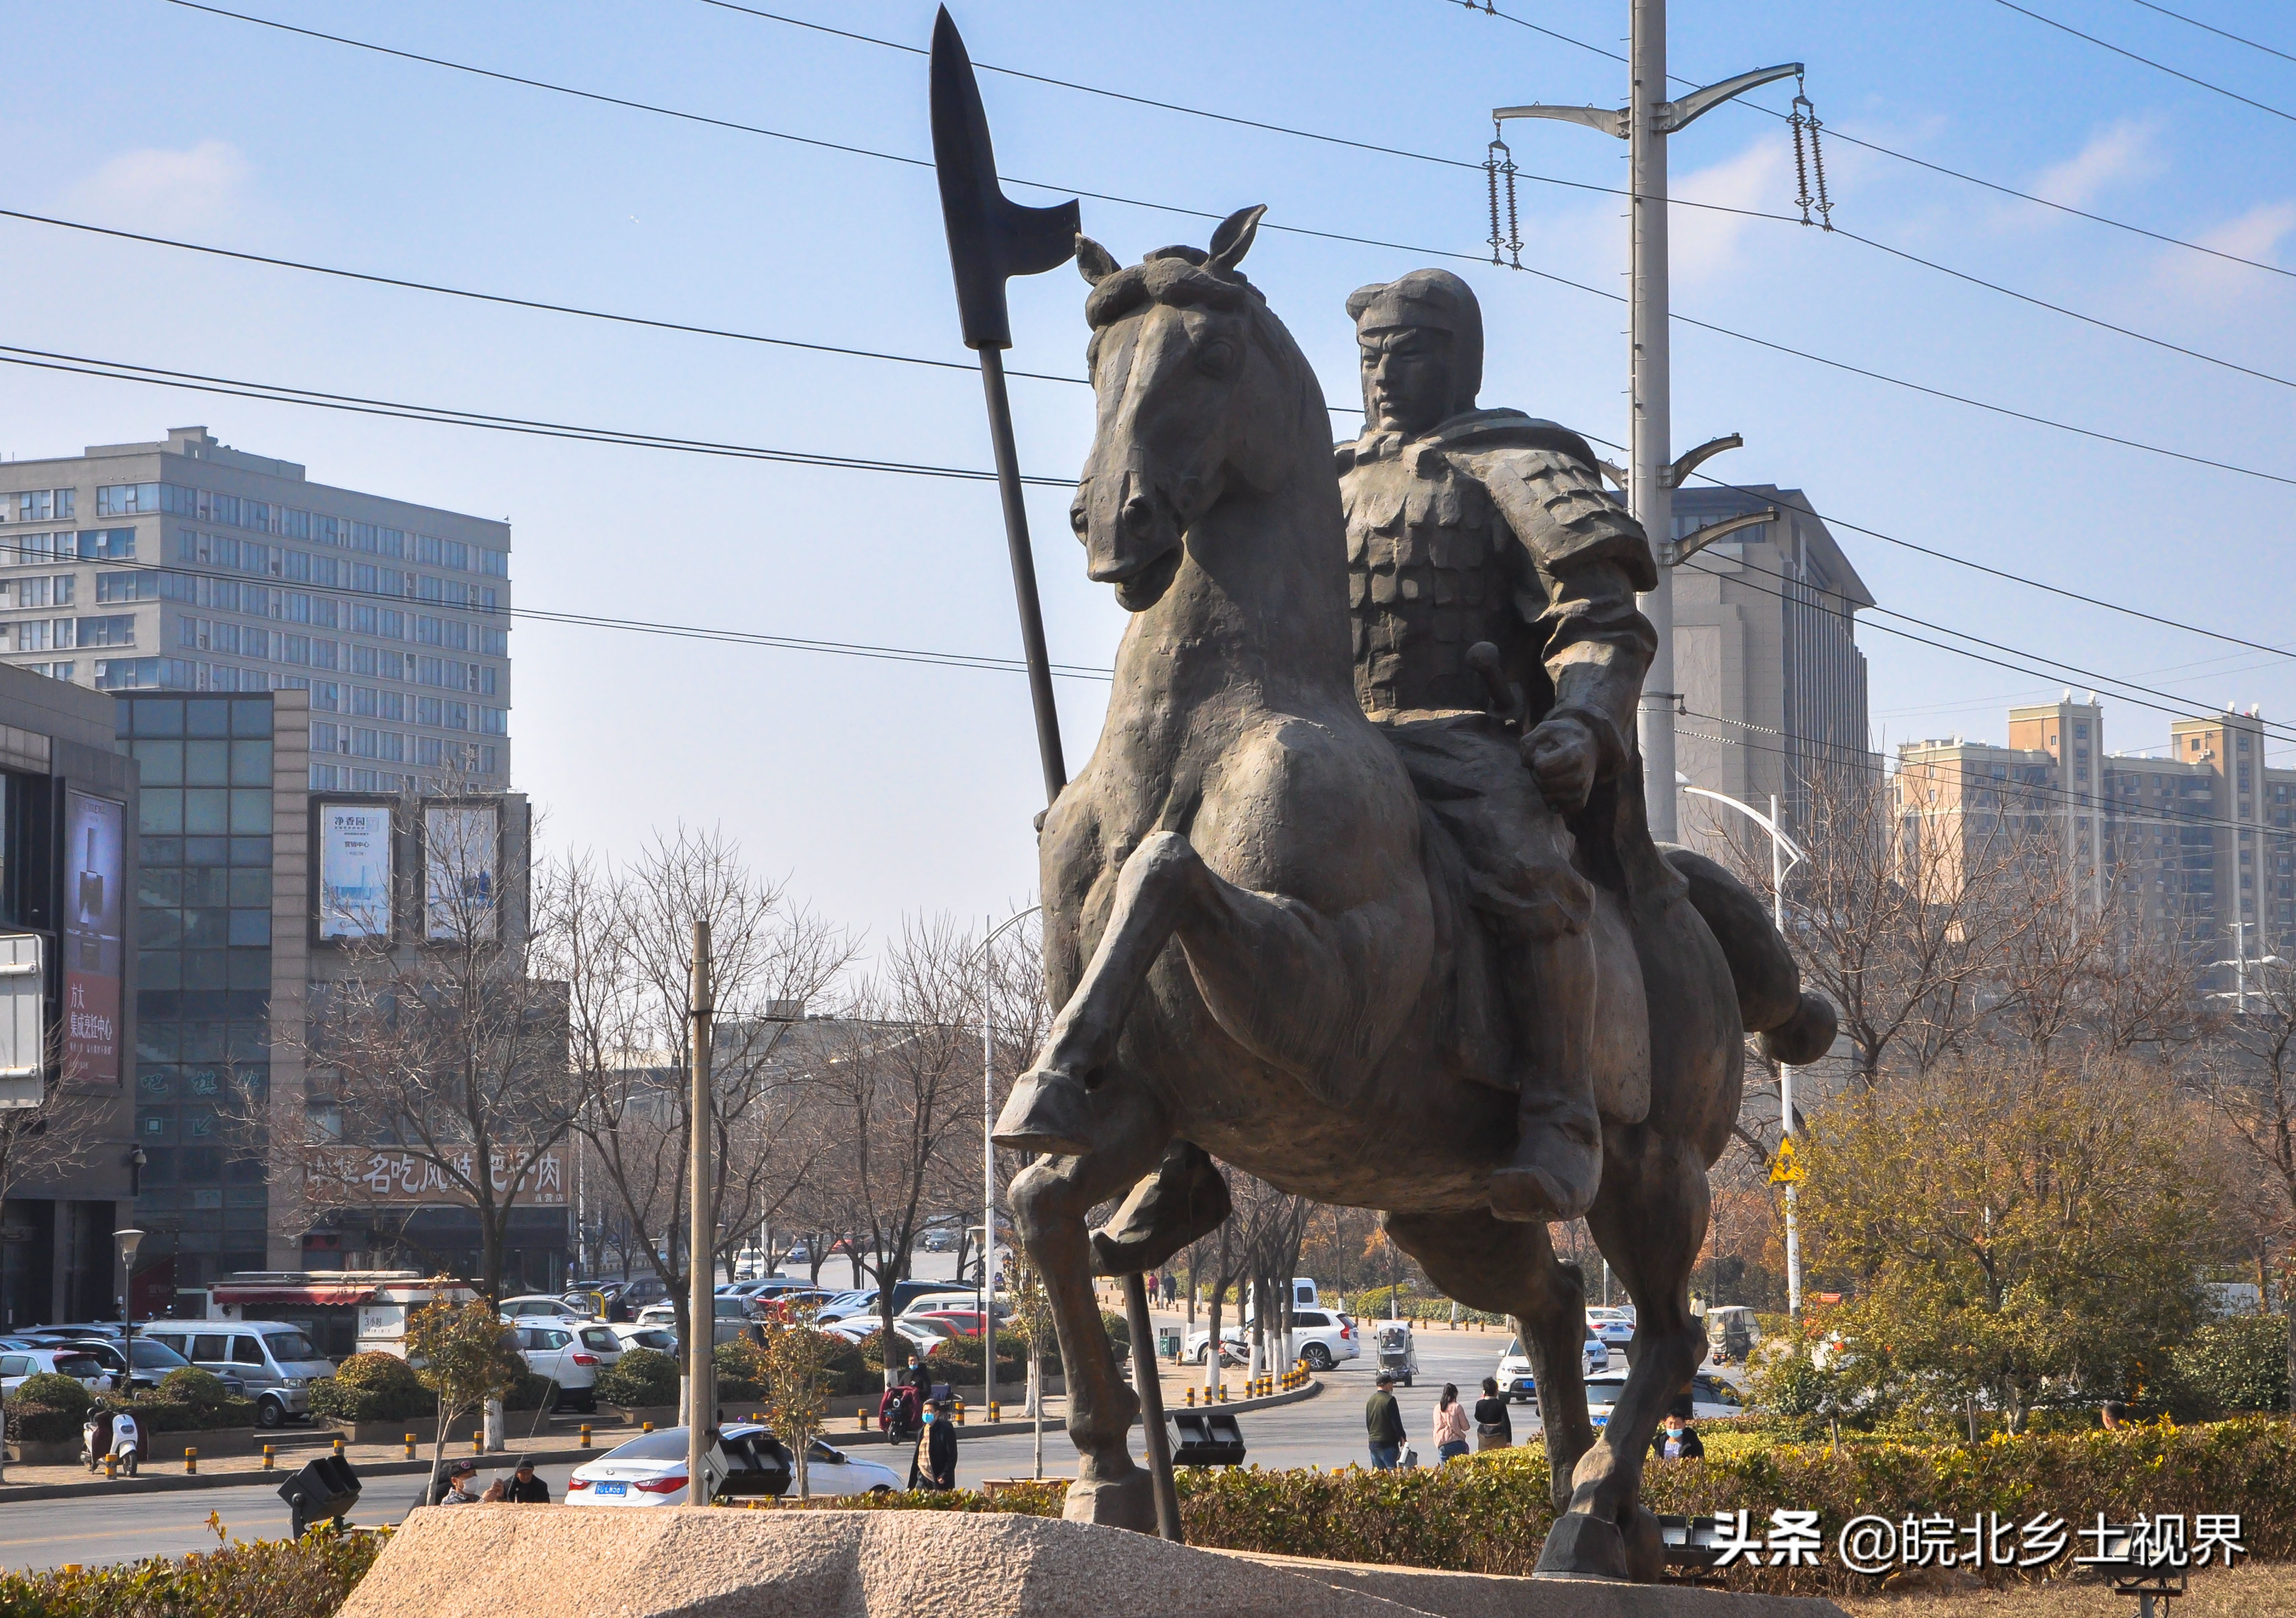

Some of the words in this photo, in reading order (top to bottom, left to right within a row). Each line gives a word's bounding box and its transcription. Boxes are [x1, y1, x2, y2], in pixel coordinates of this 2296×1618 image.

[334, 817, 365, 826] 净香园
[70, 1011, 112, 1041] 集成烹饪中心
[535, 1193, 564, 1203] 直营店
